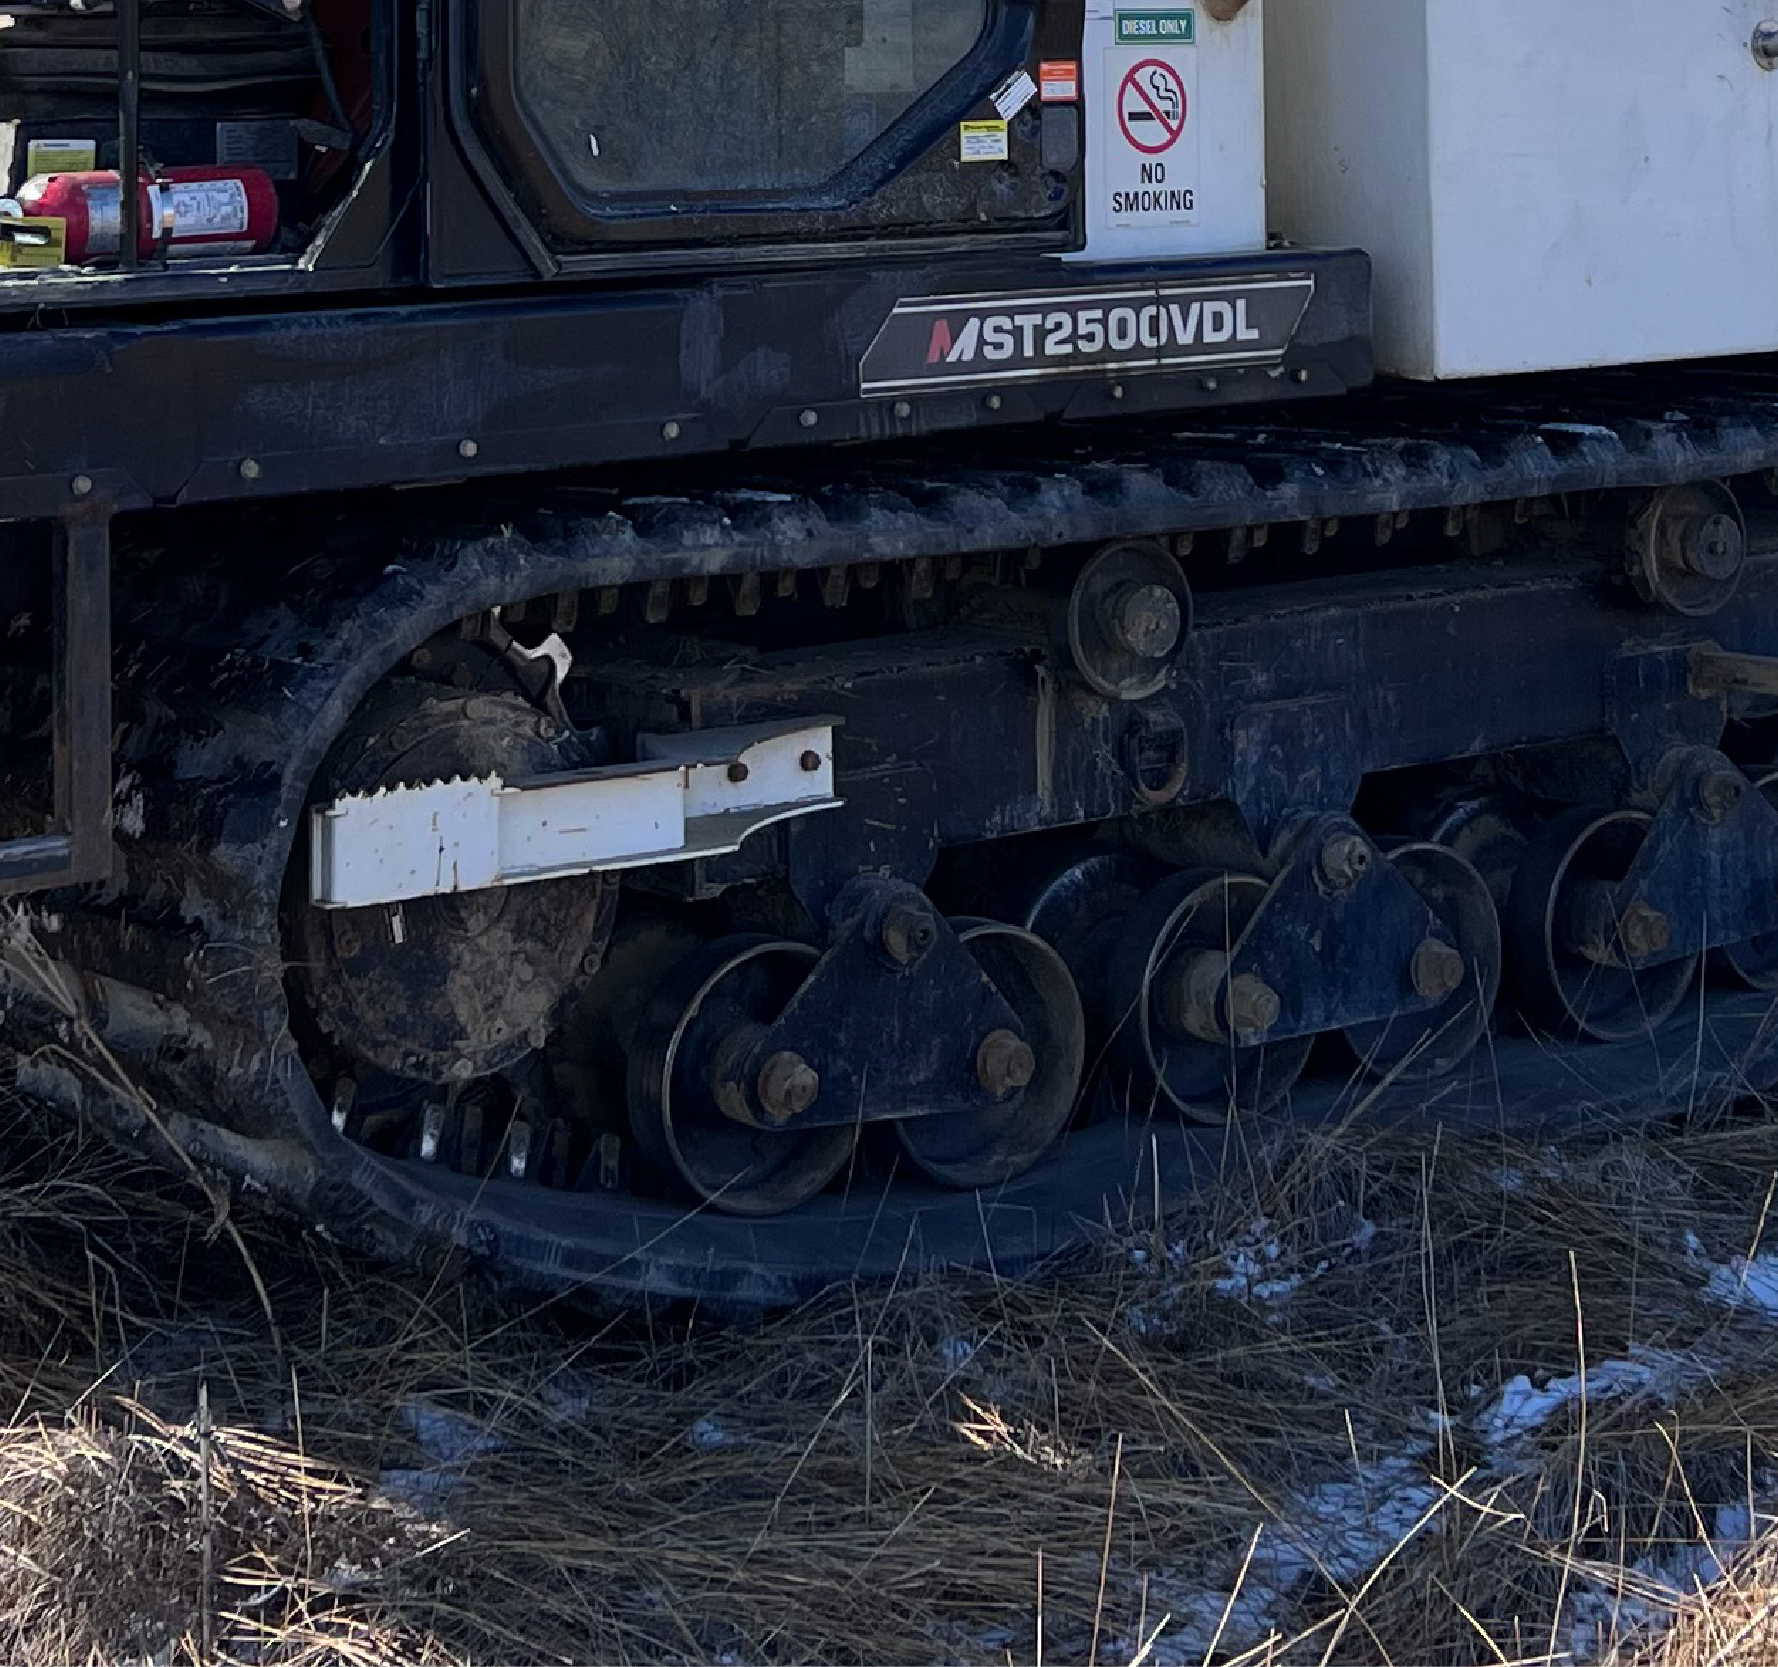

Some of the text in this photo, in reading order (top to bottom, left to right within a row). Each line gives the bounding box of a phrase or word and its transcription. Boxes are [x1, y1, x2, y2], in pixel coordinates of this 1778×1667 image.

[1121, 19, 1187, 35] DIESEL ONLY
[1140, 162, 1166, 185] NO
[1112, 189, 1194, 214] SMOKING
[927, 299, 1259, 364] MST2500VDL
